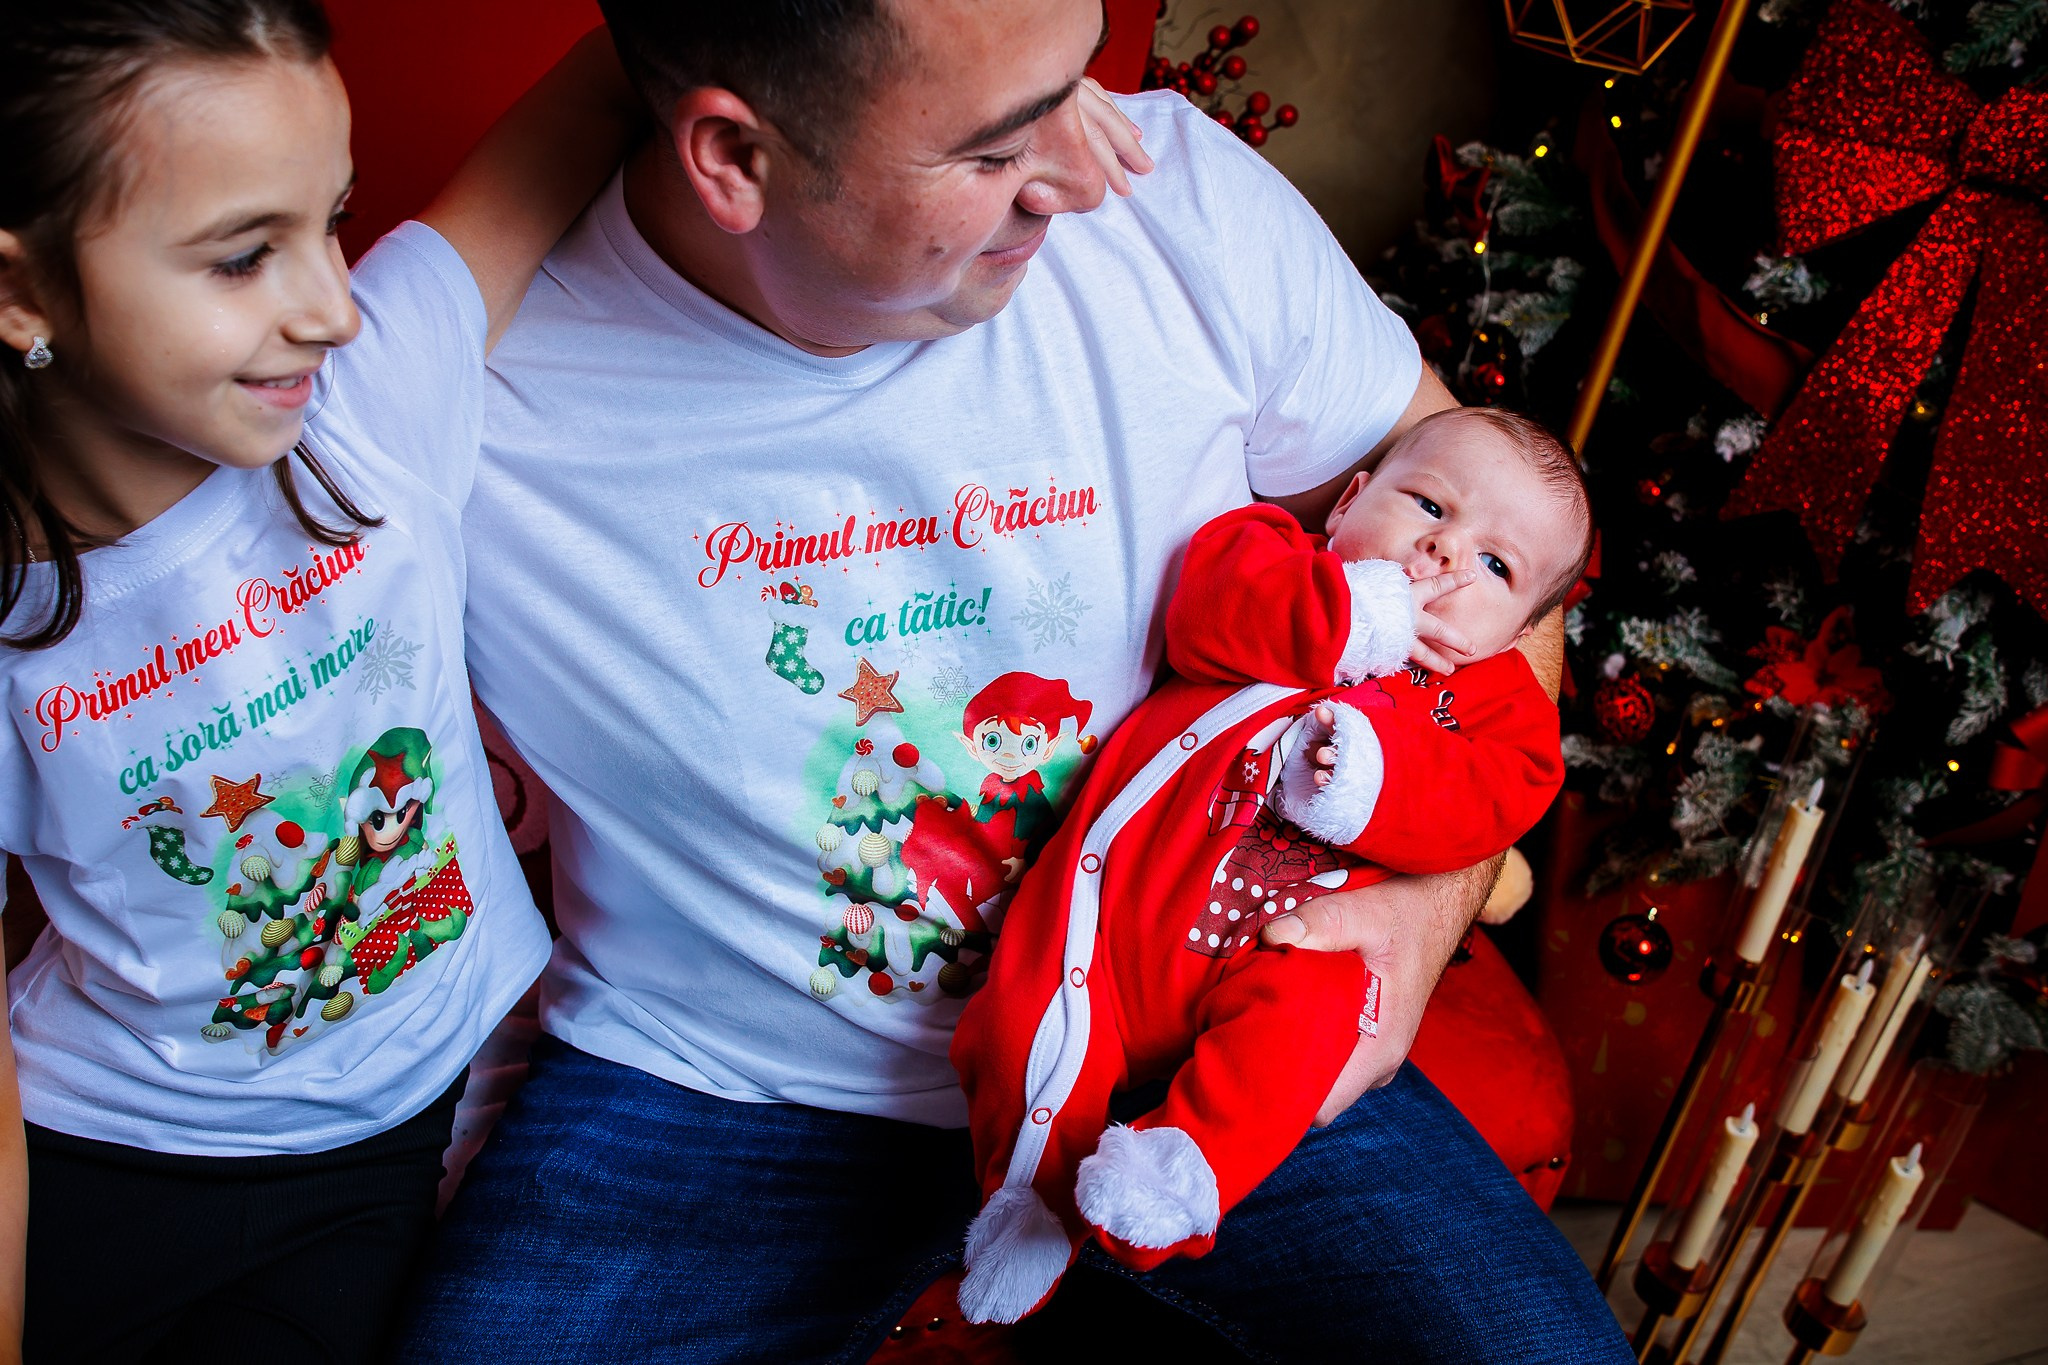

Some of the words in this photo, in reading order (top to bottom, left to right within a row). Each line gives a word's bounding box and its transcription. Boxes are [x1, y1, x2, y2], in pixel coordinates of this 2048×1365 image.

[698, 515, 857, 588] Primul
[865, 516, 942, 554] meu
[844, 612, 889, 647] ca
[35, 644, 173, 753] Primul
[175, 618, 242, 675] meu
[119, 756, 159, 795] ca
[165, 701, 242, 772] soră
[247, 666, 307, 729] mai
[310, 618, 376, 690] mare
